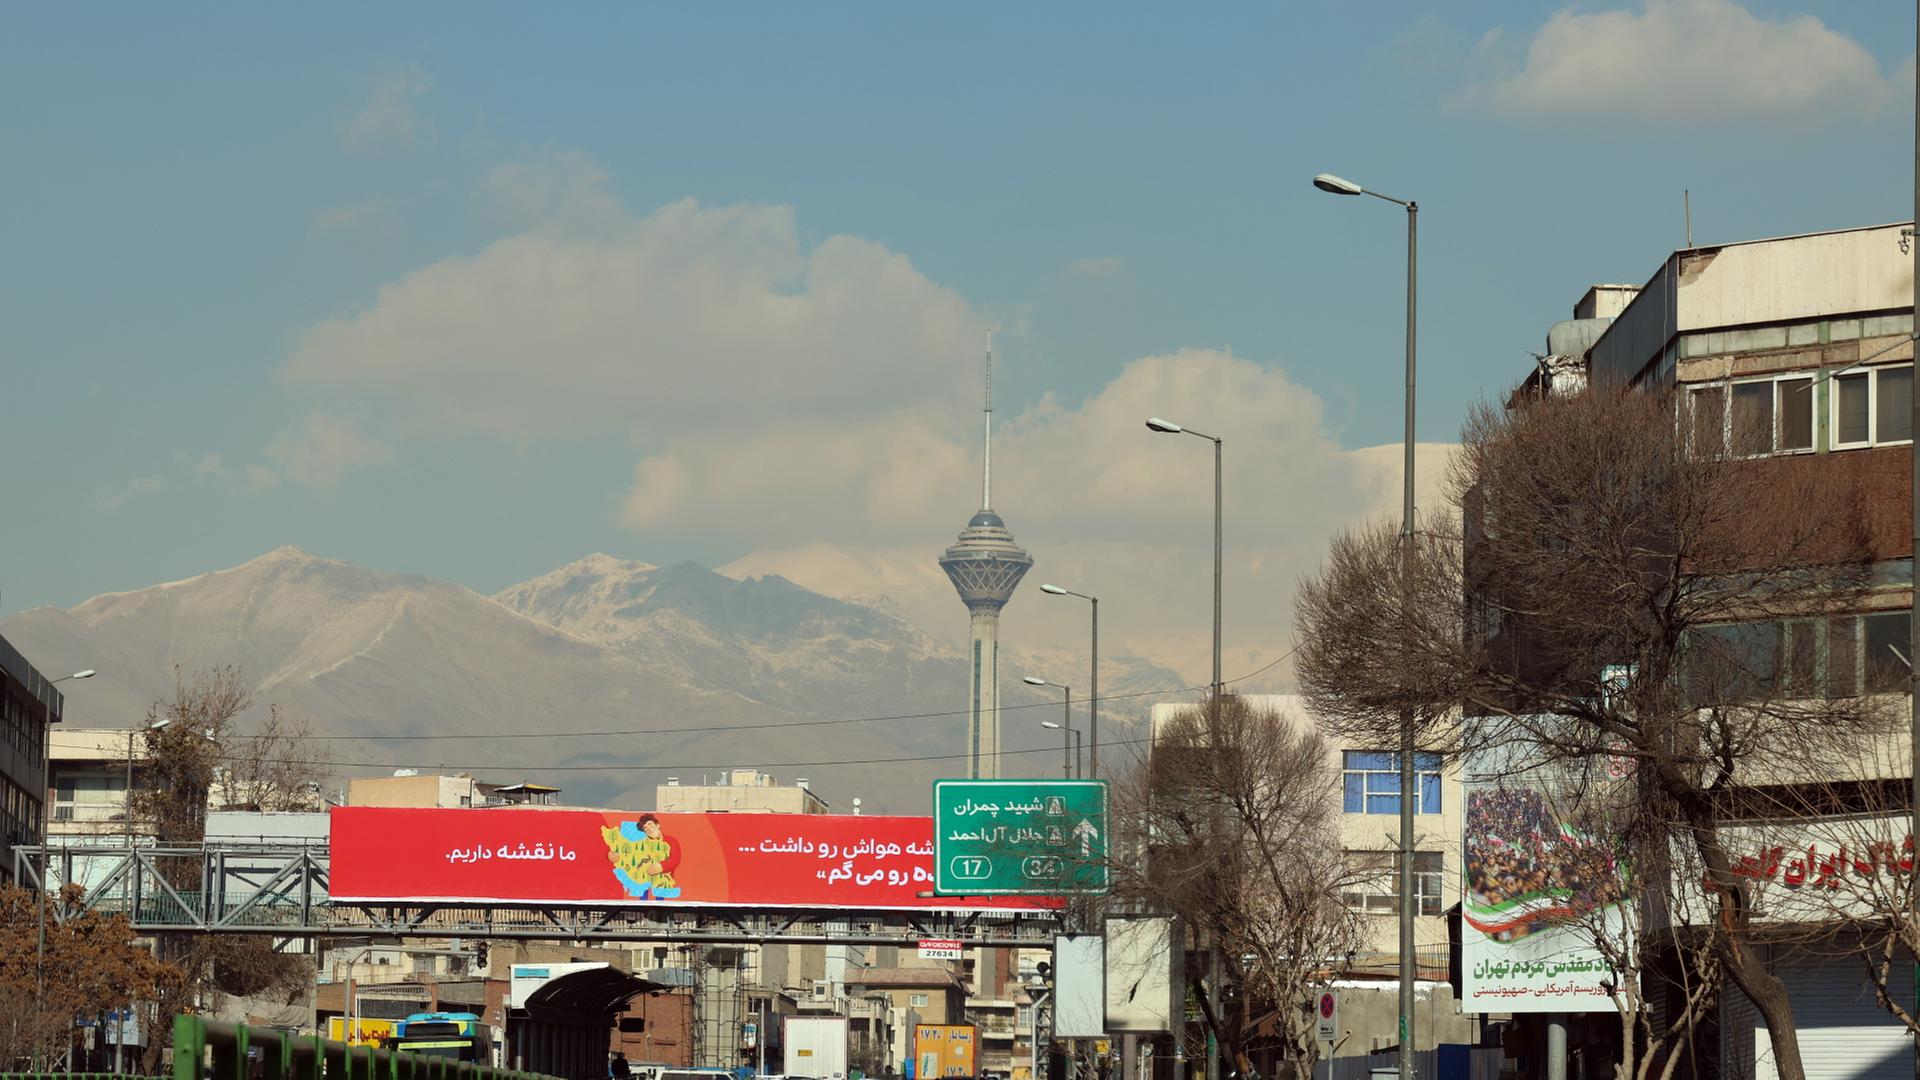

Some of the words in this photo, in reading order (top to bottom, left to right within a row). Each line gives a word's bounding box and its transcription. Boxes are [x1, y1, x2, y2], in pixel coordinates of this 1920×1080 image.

[954, 798, 1000, 818] چمران
[1004, 797, 1044, 815] شهید
[1009, 827, 1044, 844] جلال
[445, 844, 493, 864] داریم.
[496, 842, 555, 860] نقشه
[558, 846, 577, 861] ما
[759, 837, 814, 854] داشت
[818, 842, 838, 859] رو
[842, 838, 901, 859] هواش
[962, 859, 982, 876] 17
[1030, 860, 1055, 876] 34
[887, 869, 909, 886] رو
[1473, 958, 1510, 979] تهران
[1511, 960, 1545, 979] مردم
